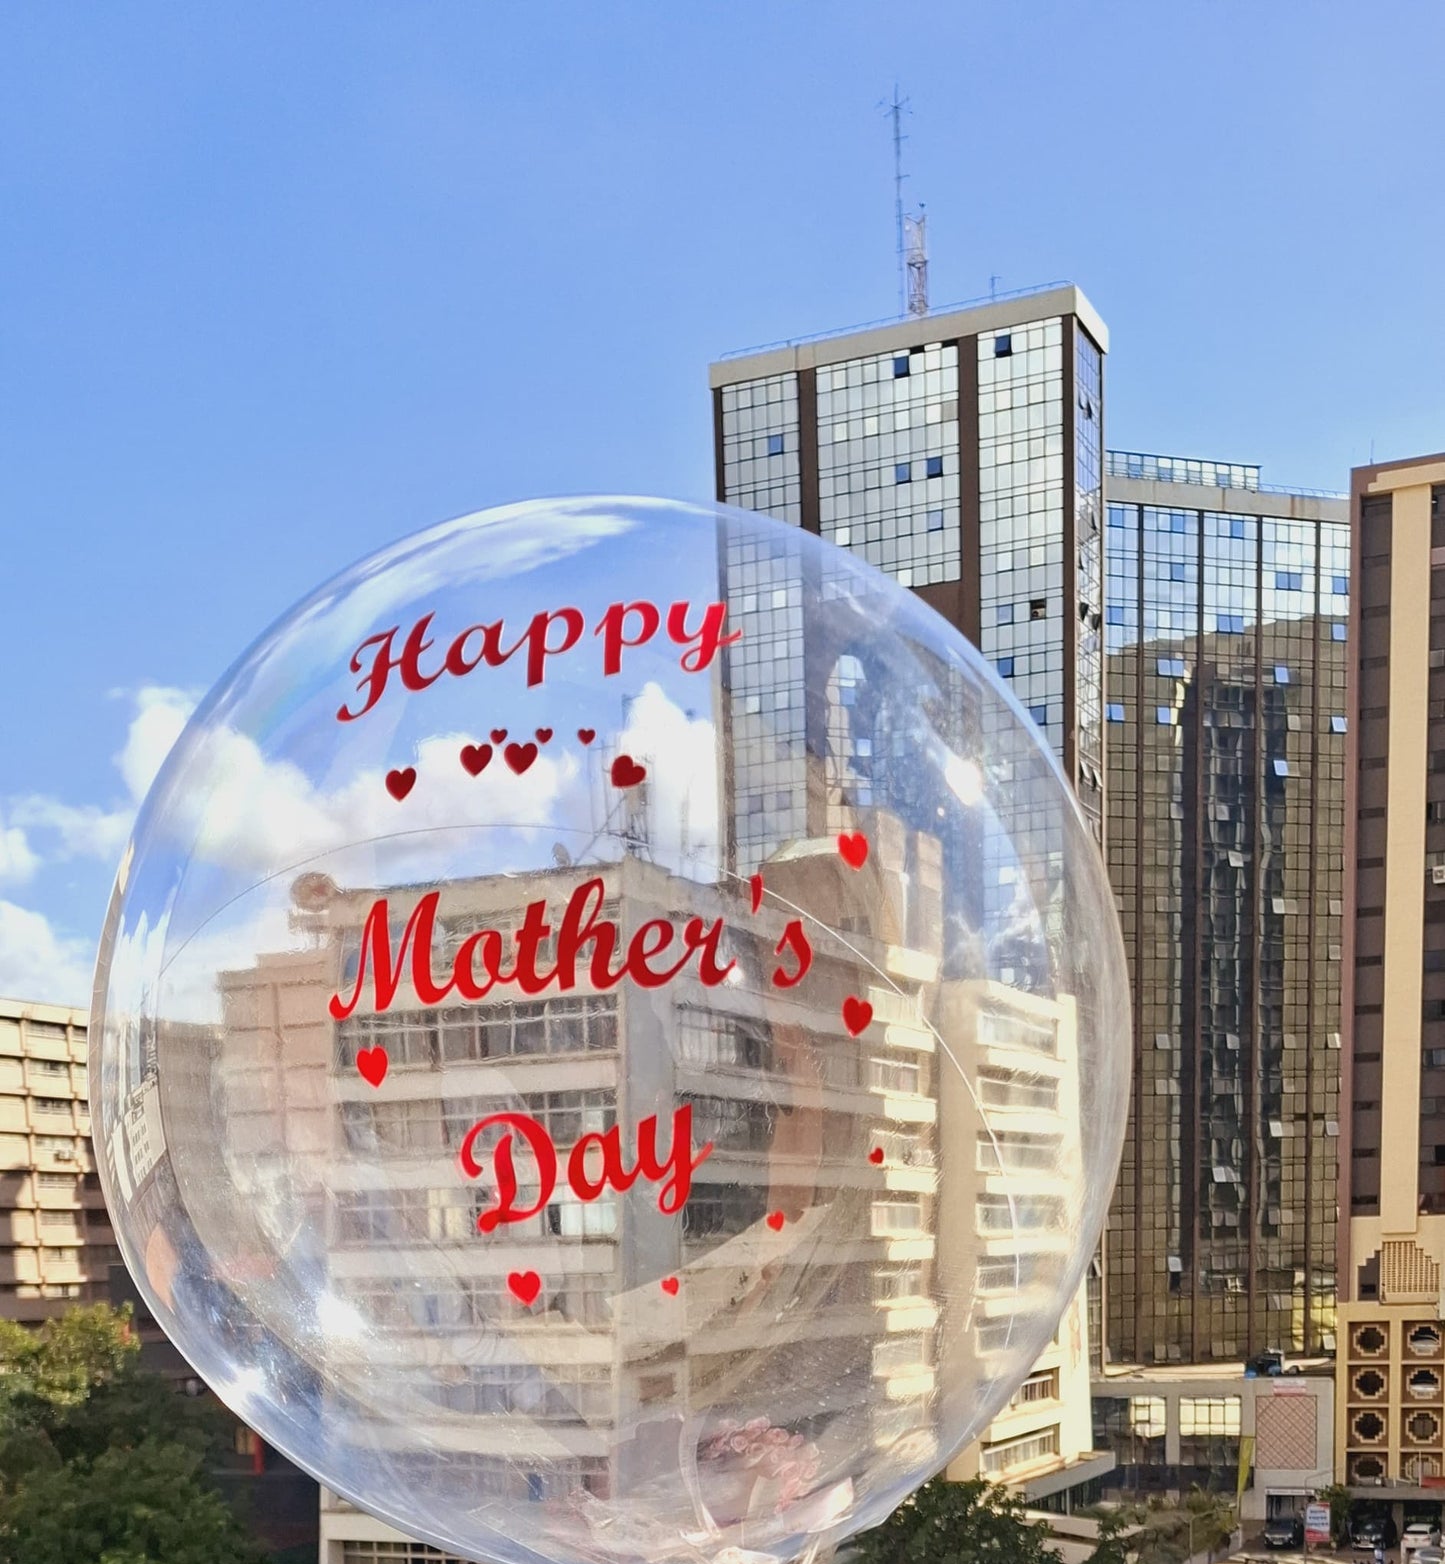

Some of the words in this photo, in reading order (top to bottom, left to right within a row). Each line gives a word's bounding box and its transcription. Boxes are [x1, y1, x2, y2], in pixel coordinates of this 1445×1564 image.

[337, 600, 742, 721] Happy
[329, 875, 813, 1021] Mother's
[461, 1104, 712, 1233] Day
